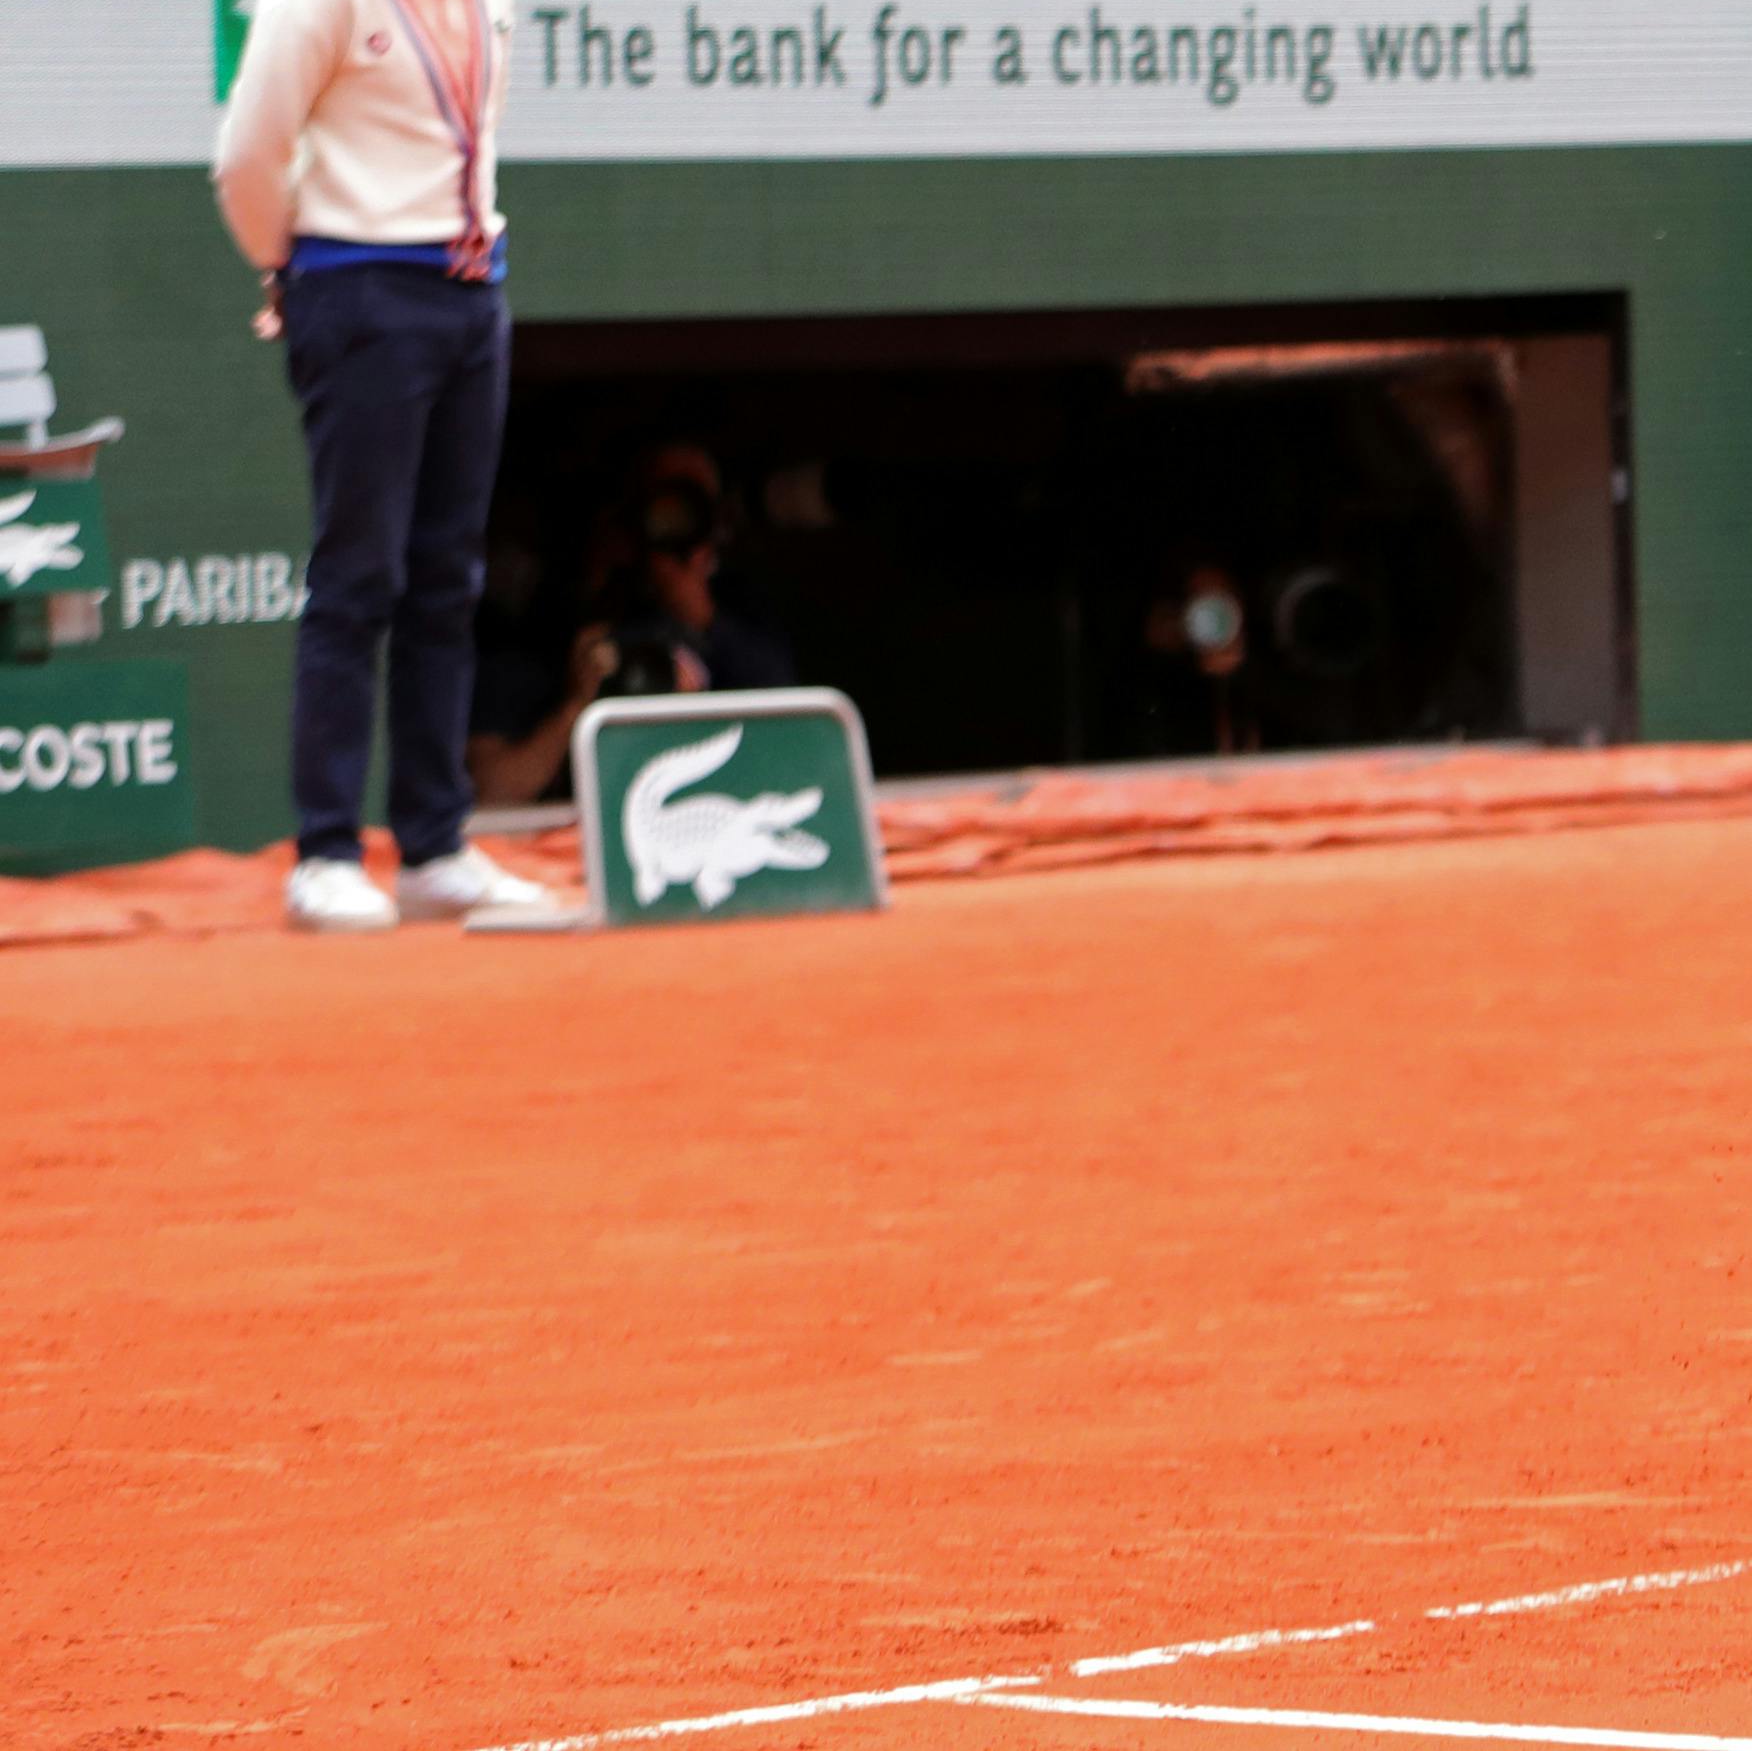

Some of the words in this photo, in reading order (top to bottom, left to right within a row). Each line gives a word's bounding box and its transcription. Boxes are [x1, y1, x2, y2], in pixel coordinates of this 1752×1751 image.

[531, 4, 656, 88] The
[684, 3, 848, 88] bank
[867, 2, 967, 109] for
[992, 25, 1030, 85] a
[1051, 4, 1337, 107] changing
[1357, 2, 1537, 83] world
[120, 550, 312, 630] PARIB
